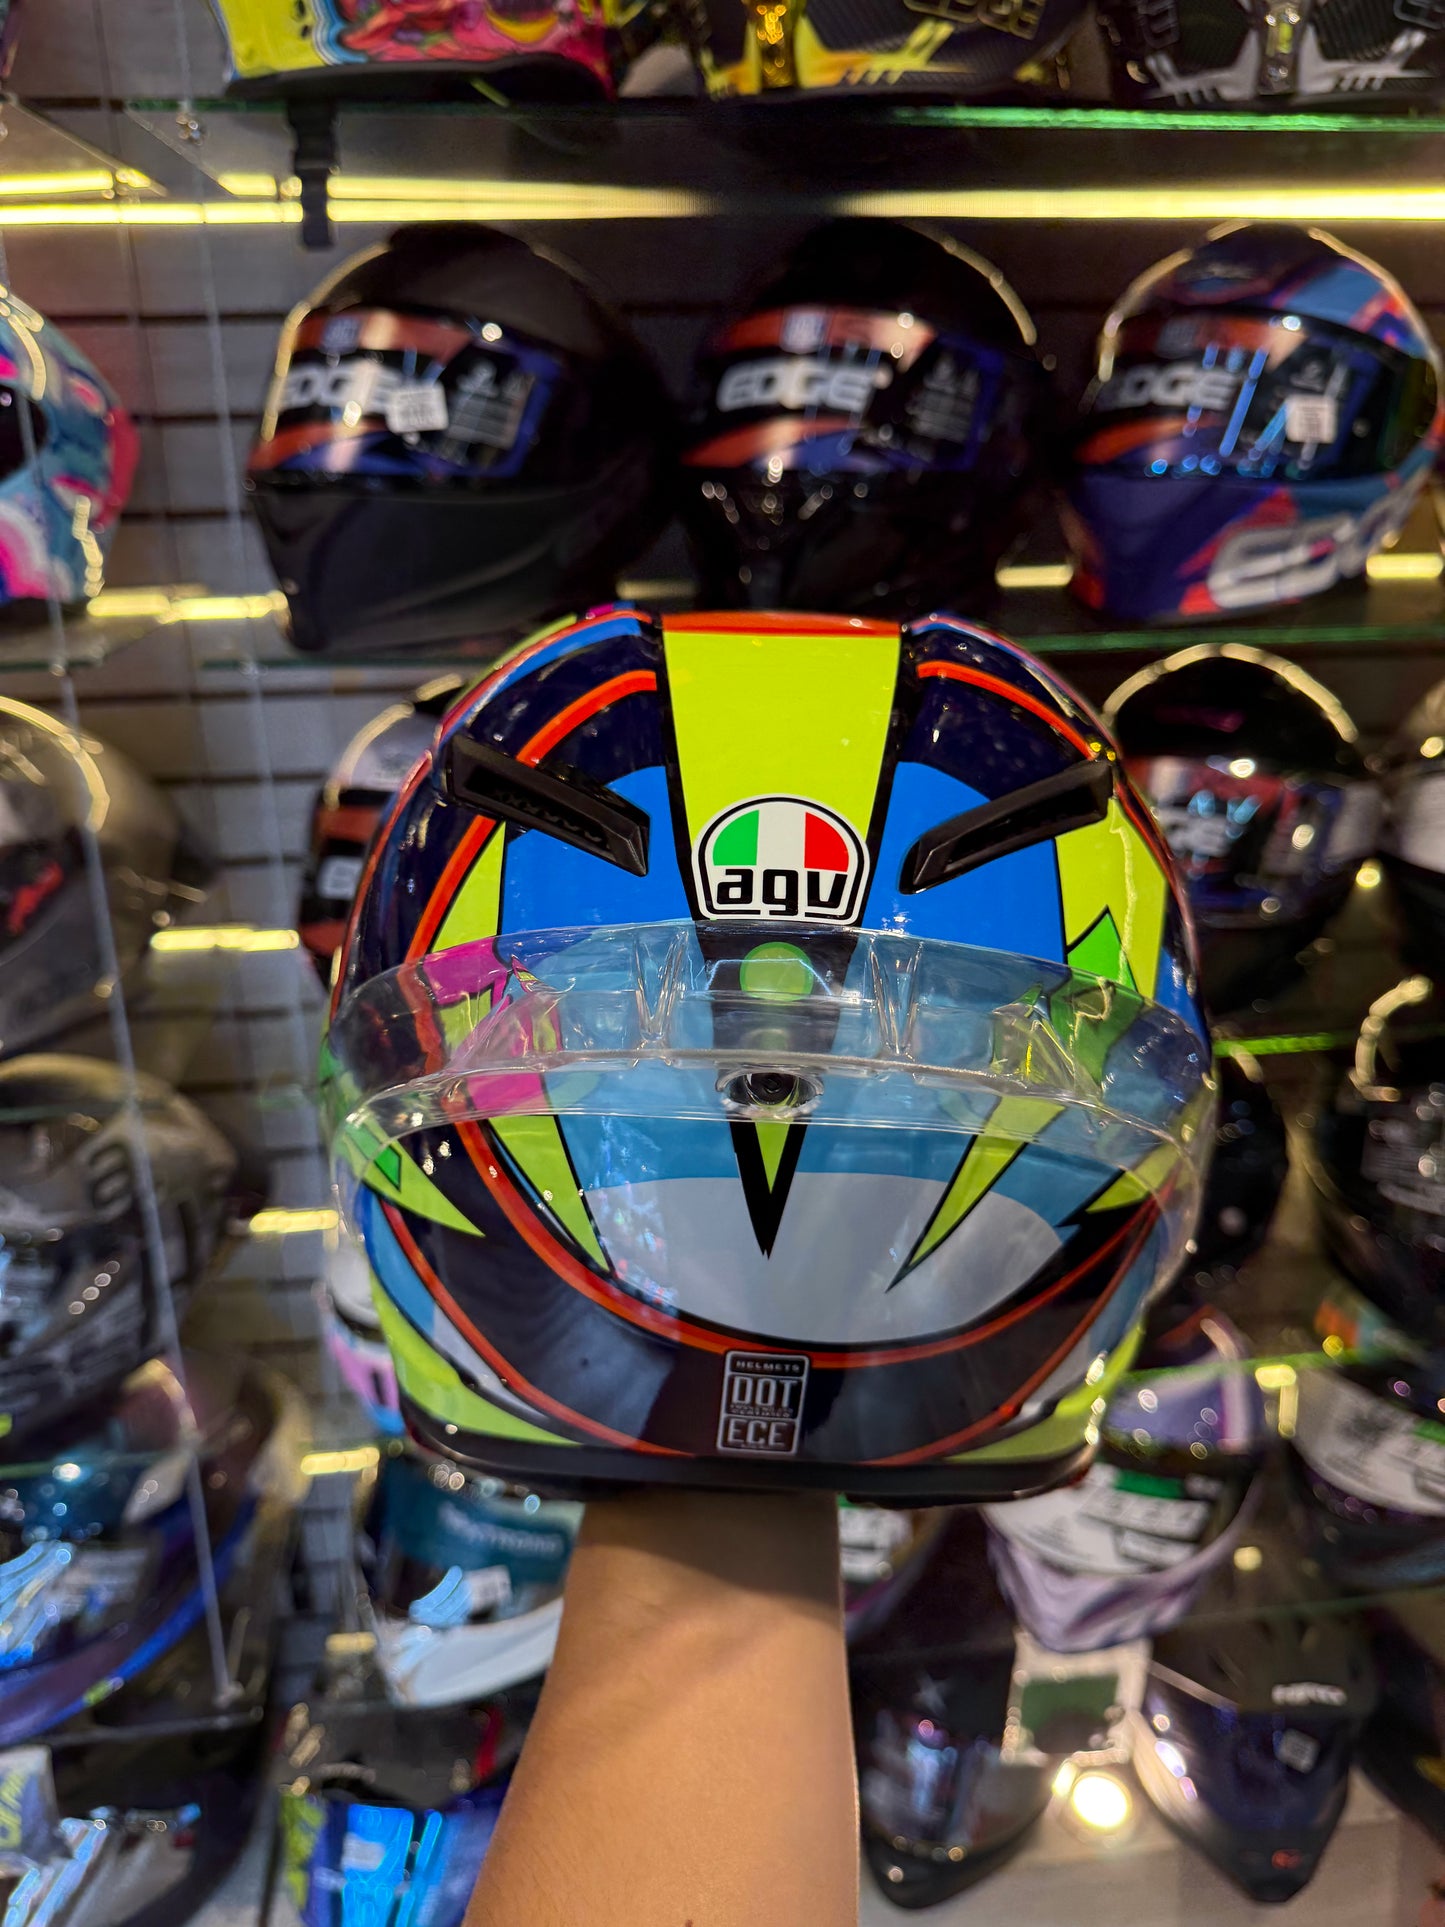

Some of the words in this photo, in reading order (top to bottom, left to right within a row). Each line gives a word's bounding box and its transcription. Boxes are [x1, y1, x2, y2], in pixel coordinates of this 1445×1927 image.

[717, 357, 875, 413] EDGE
[716, 868, 848, 916] agv
[736, 1361, 800, 1371] HELMETS
[732, 1376, 798, 1408] DOT
[727, 1418, 788, 1446] ECE
